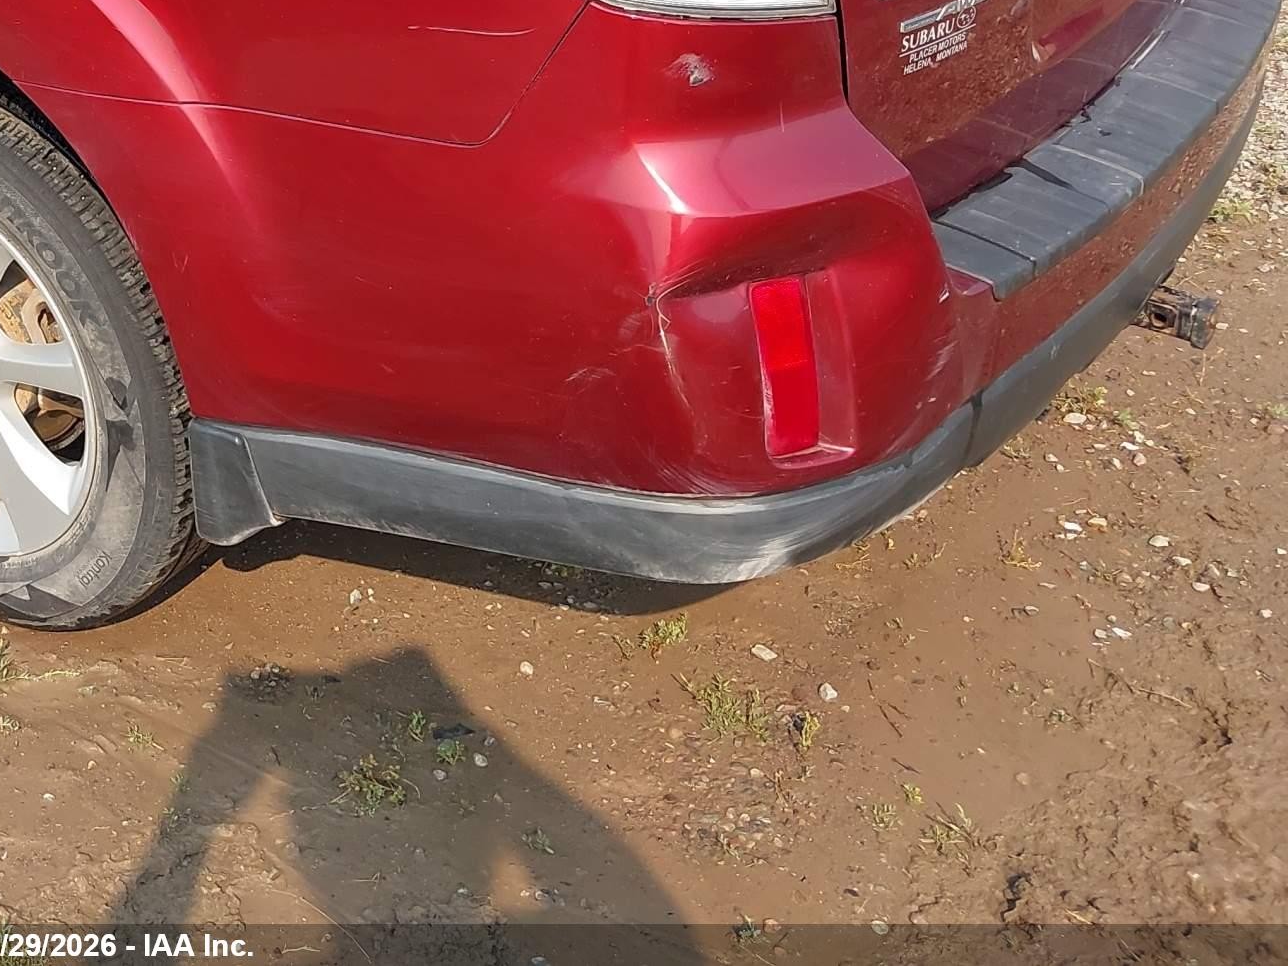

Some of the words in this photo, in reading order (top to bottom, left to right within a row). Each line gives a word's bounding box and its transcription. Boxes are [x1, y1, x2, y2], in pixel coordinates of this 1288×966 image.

[901, 17, 956, 52] SUBARU
[909, 44, 938, 64] PLACER
[937, 31, 967, 52] MOTORS
[935, 40, 969, 62] MONTANA
